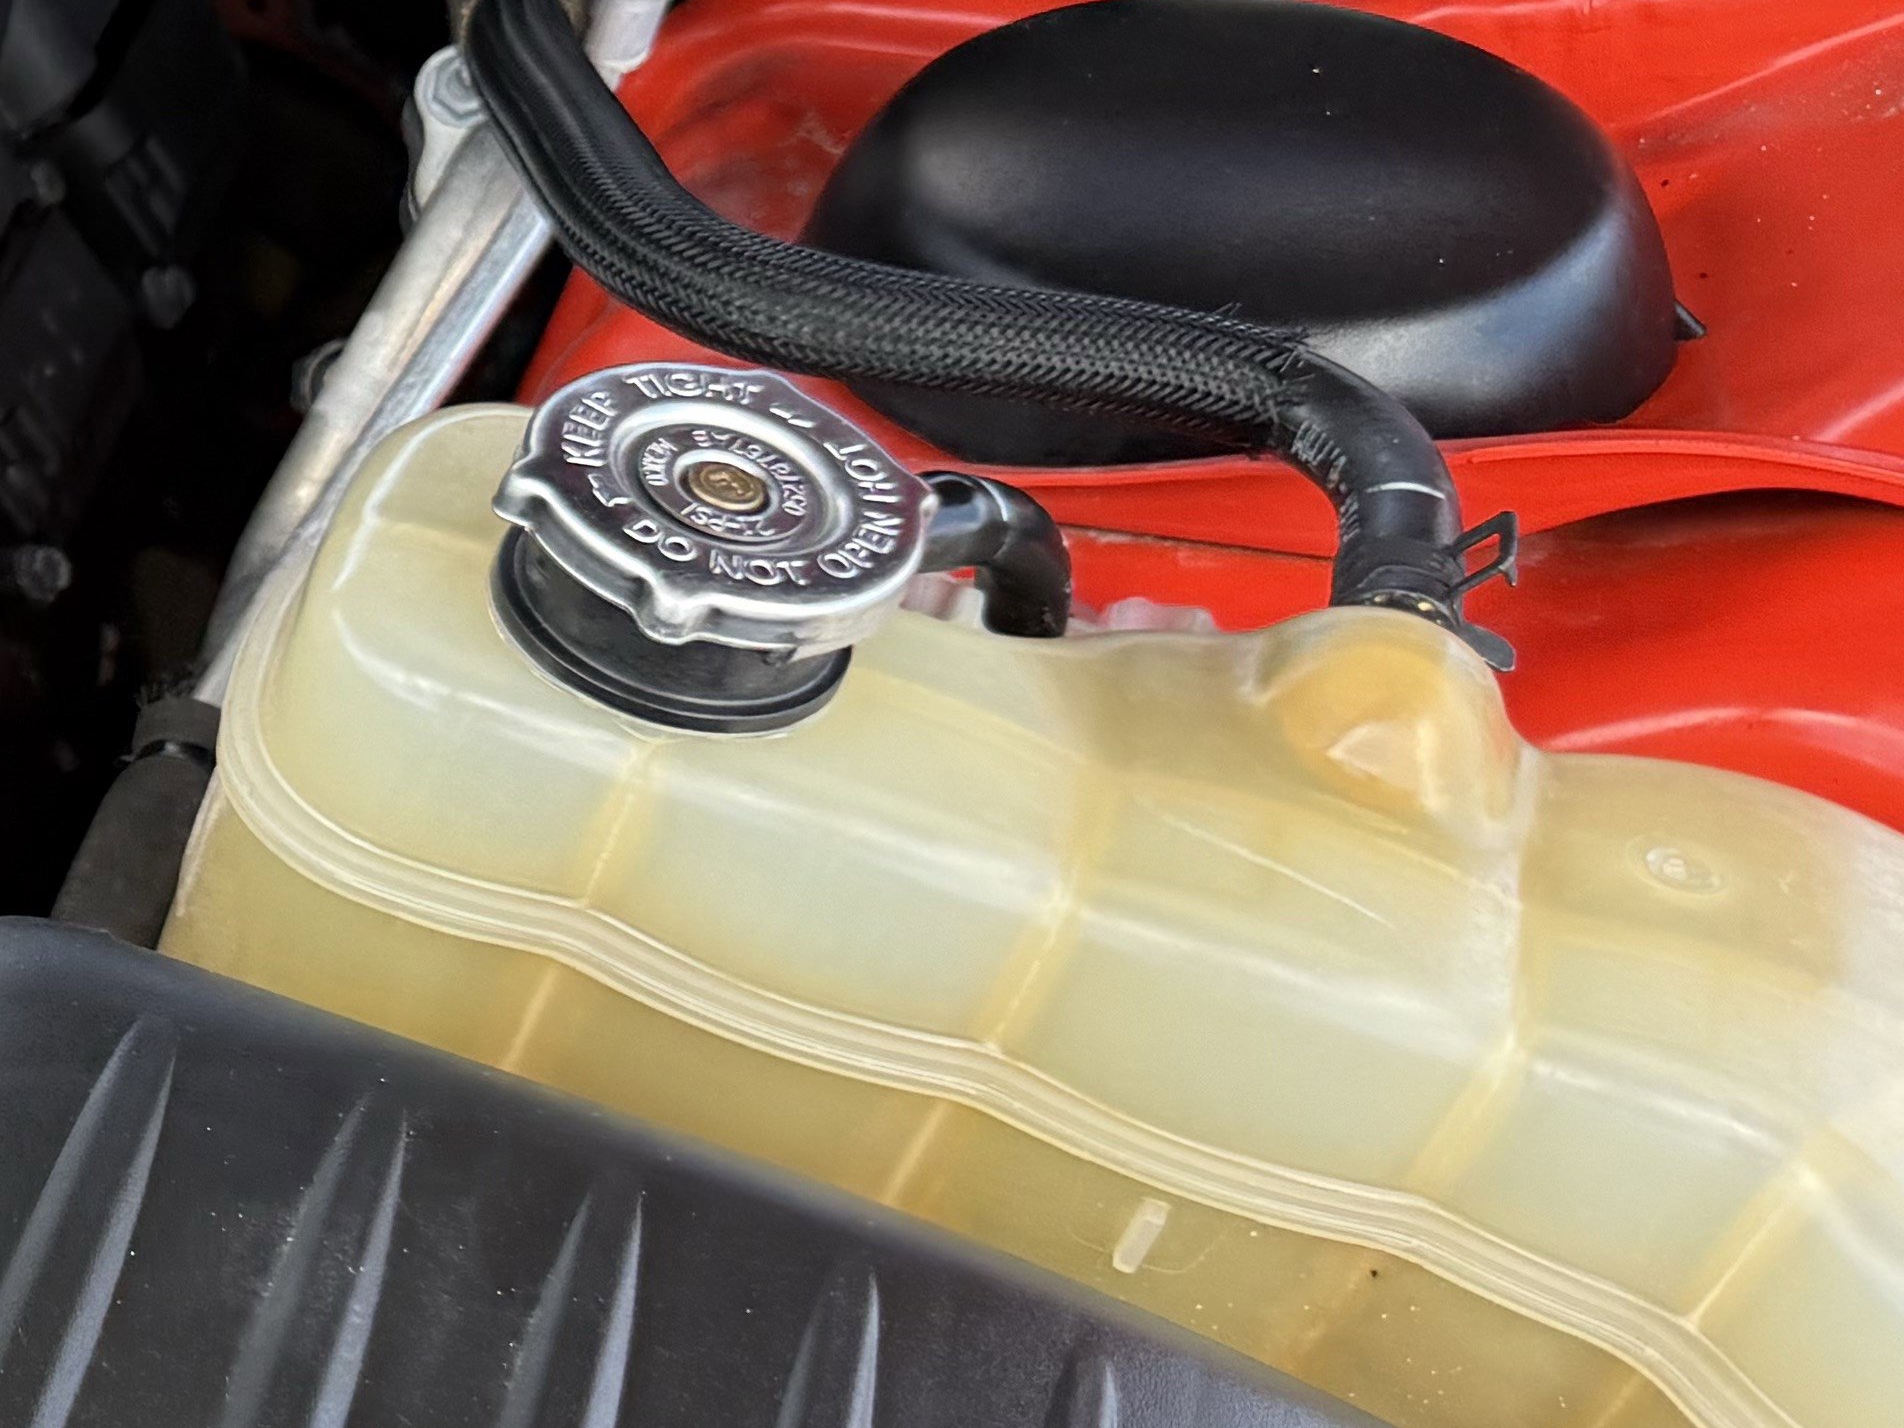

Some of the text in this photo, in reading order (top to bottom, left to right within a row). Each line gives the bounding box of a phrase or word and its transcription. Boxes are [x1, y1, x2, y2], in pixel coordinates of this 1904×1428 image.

[561, 373, 766, 468] KEEP TIGHT
[623, 440, 907, 586] DO NOT OPEN HOT
